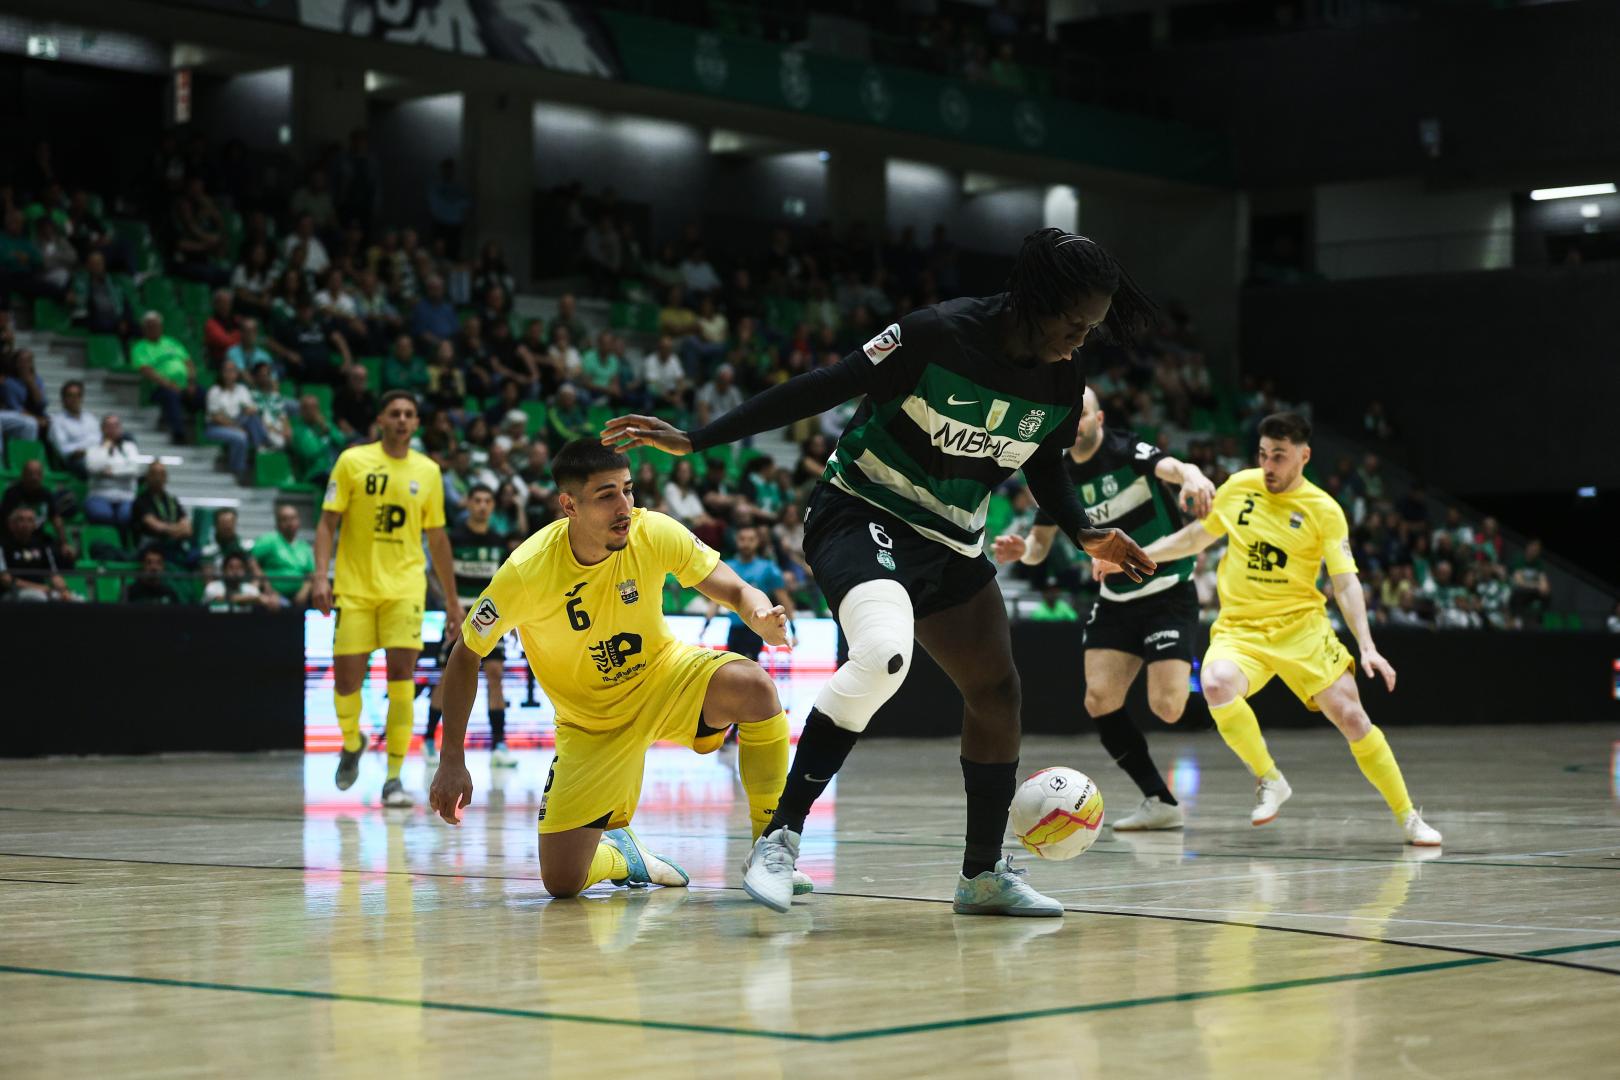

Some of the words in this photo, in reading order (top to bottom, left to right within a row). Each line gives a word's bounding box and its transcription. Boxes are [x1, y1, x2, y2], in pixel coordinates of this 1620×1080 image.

[365, 473, 389, 496] 87
[1237, 499, 1254, 525] 2
[869, 522, 893, 549] 6
[565, 597, 591, 631] 6
